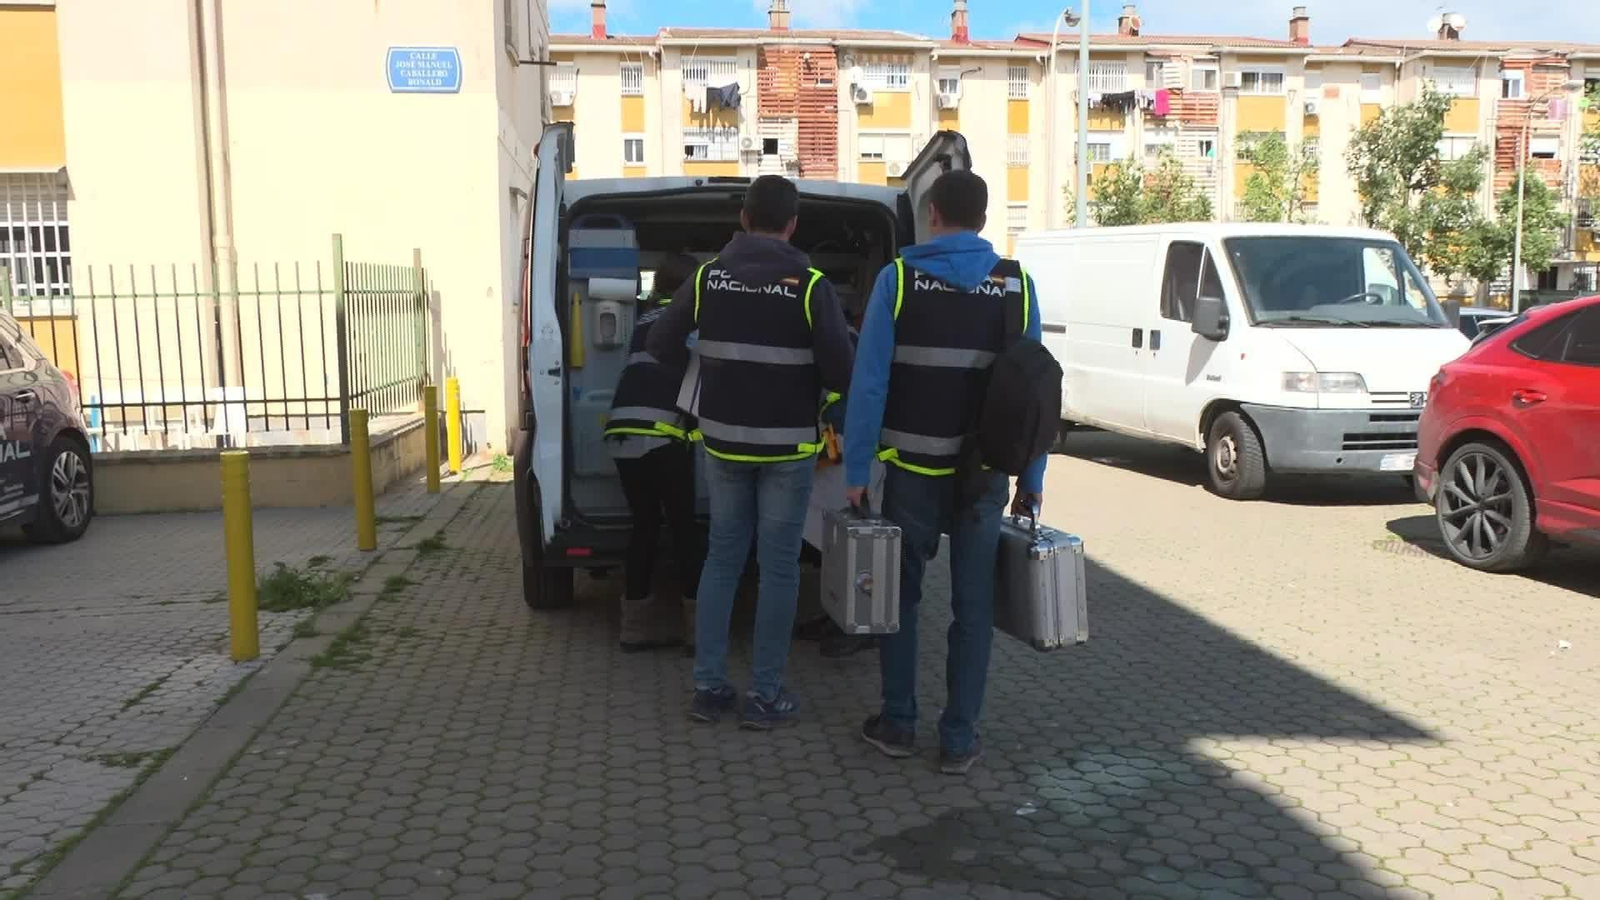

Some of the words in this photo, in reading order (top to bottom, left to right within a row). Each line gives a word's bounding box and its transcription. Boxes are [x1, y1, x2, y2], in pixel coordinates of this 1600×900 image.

[409, 52, 436, 60] CALLE
[417, 61, 453, 69] MANUEL
[400, 69, 448, 77] CABALLERO
